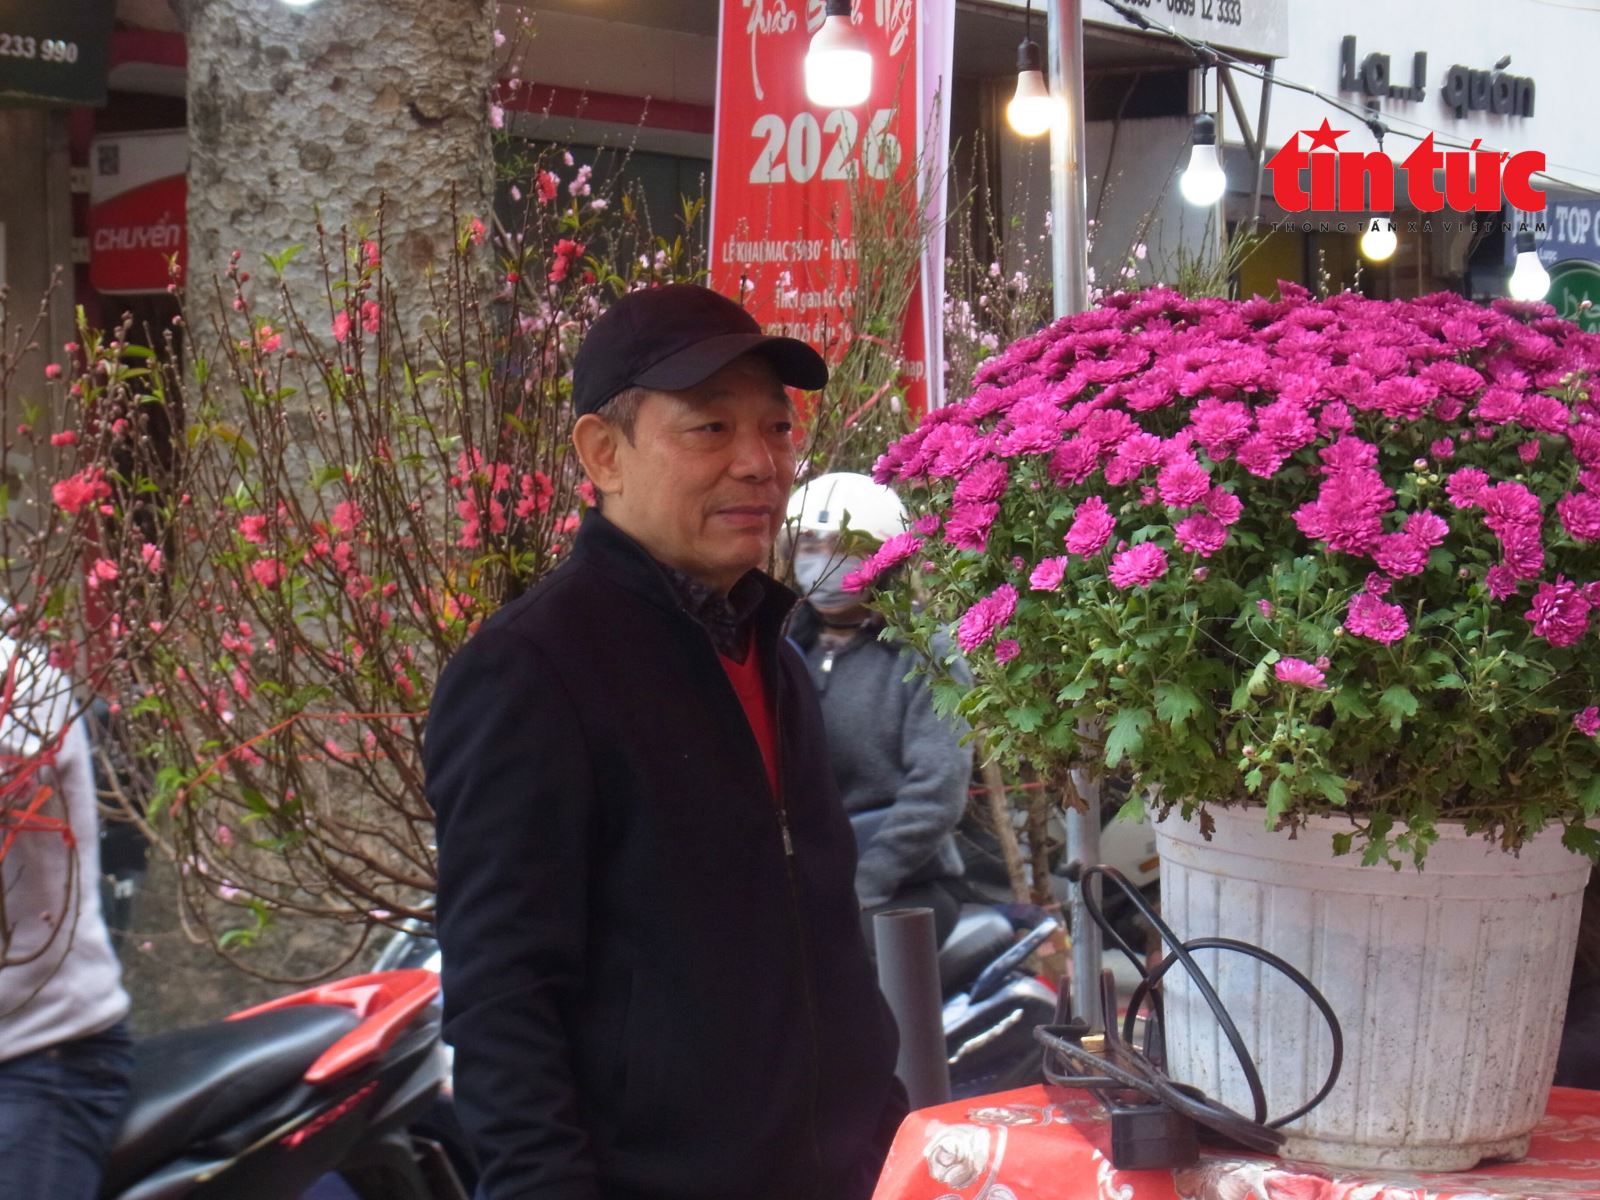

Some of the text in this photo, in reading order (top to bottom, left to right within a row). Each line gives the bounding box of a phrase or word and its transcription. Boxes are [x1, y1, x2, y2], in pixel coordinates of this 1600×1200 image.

[1201, 0, 1213, 20] 12
[1217, 0, 1241, 26] 3333
[0, 33, 79, 63] 233 990
[1441, 55, 1535, 118] quán
[749, 109, 901, 184] 2026
[1556, 205, 1591, 244] TOP
